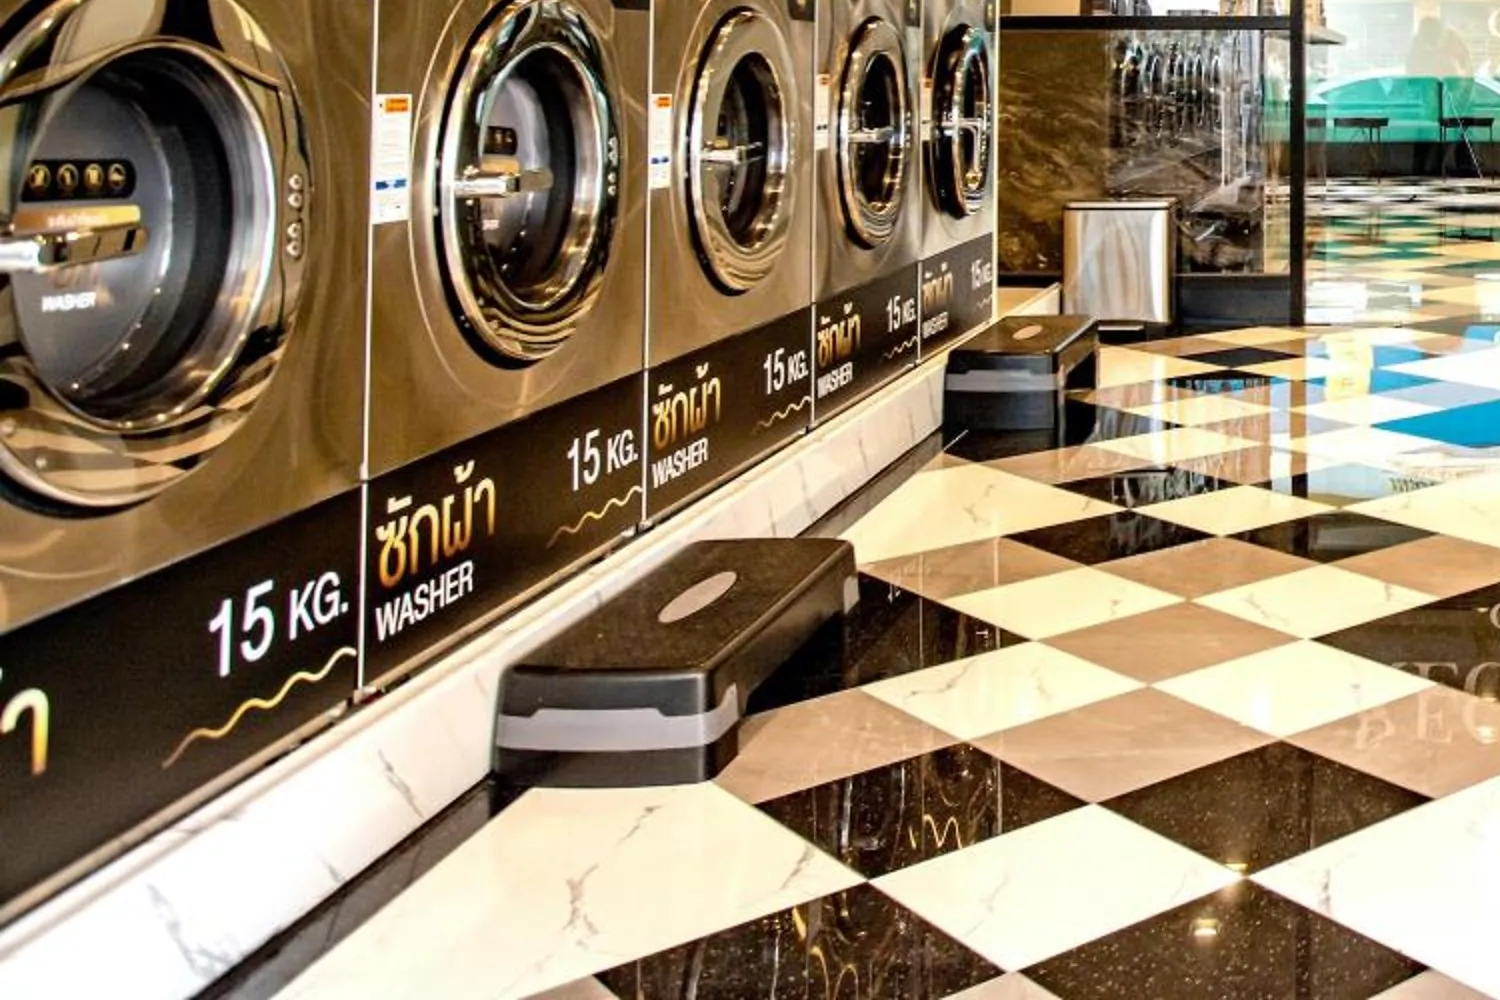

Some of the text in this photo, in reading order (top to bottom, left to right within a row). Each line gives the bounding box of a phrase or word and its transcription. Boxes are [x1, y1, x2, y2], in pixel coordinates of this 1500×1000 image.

[971, 259, 982, 290] 15
[886, 295, 901, 333] 15
[763, 348, 810, 395] 15 KG.
[817, 361, 853, 399] WASHER
[652, 362, 721, 450] ซักผ้า
[567, 428, 638, 492] 15 KG.
[651, 437, 709, 489] WASHER
[375, 460, 496, 588] ซักผ้า
[208, 570, 349, 678] 15 KG.
[375, 560, 474, 641] WASHER
